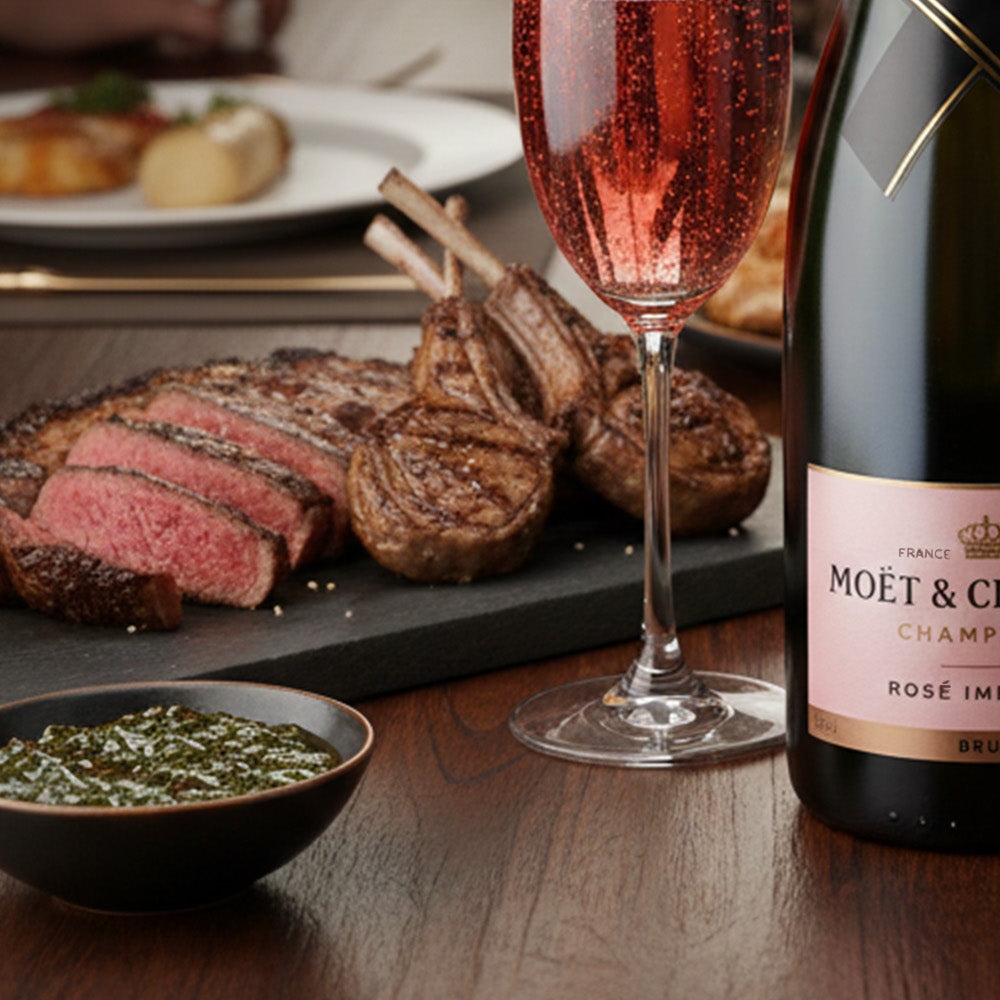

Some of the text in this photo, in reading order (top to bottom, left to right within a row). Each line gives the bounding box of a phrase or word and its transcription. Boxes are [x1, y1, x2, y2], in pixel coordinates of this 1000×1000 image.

[898, 547, 951, 560] FRANCE
[829, 564, 920, 605] MOËT
[931, 578, 957, 609] &
[888, 680, 951, 700] ROSÉ
